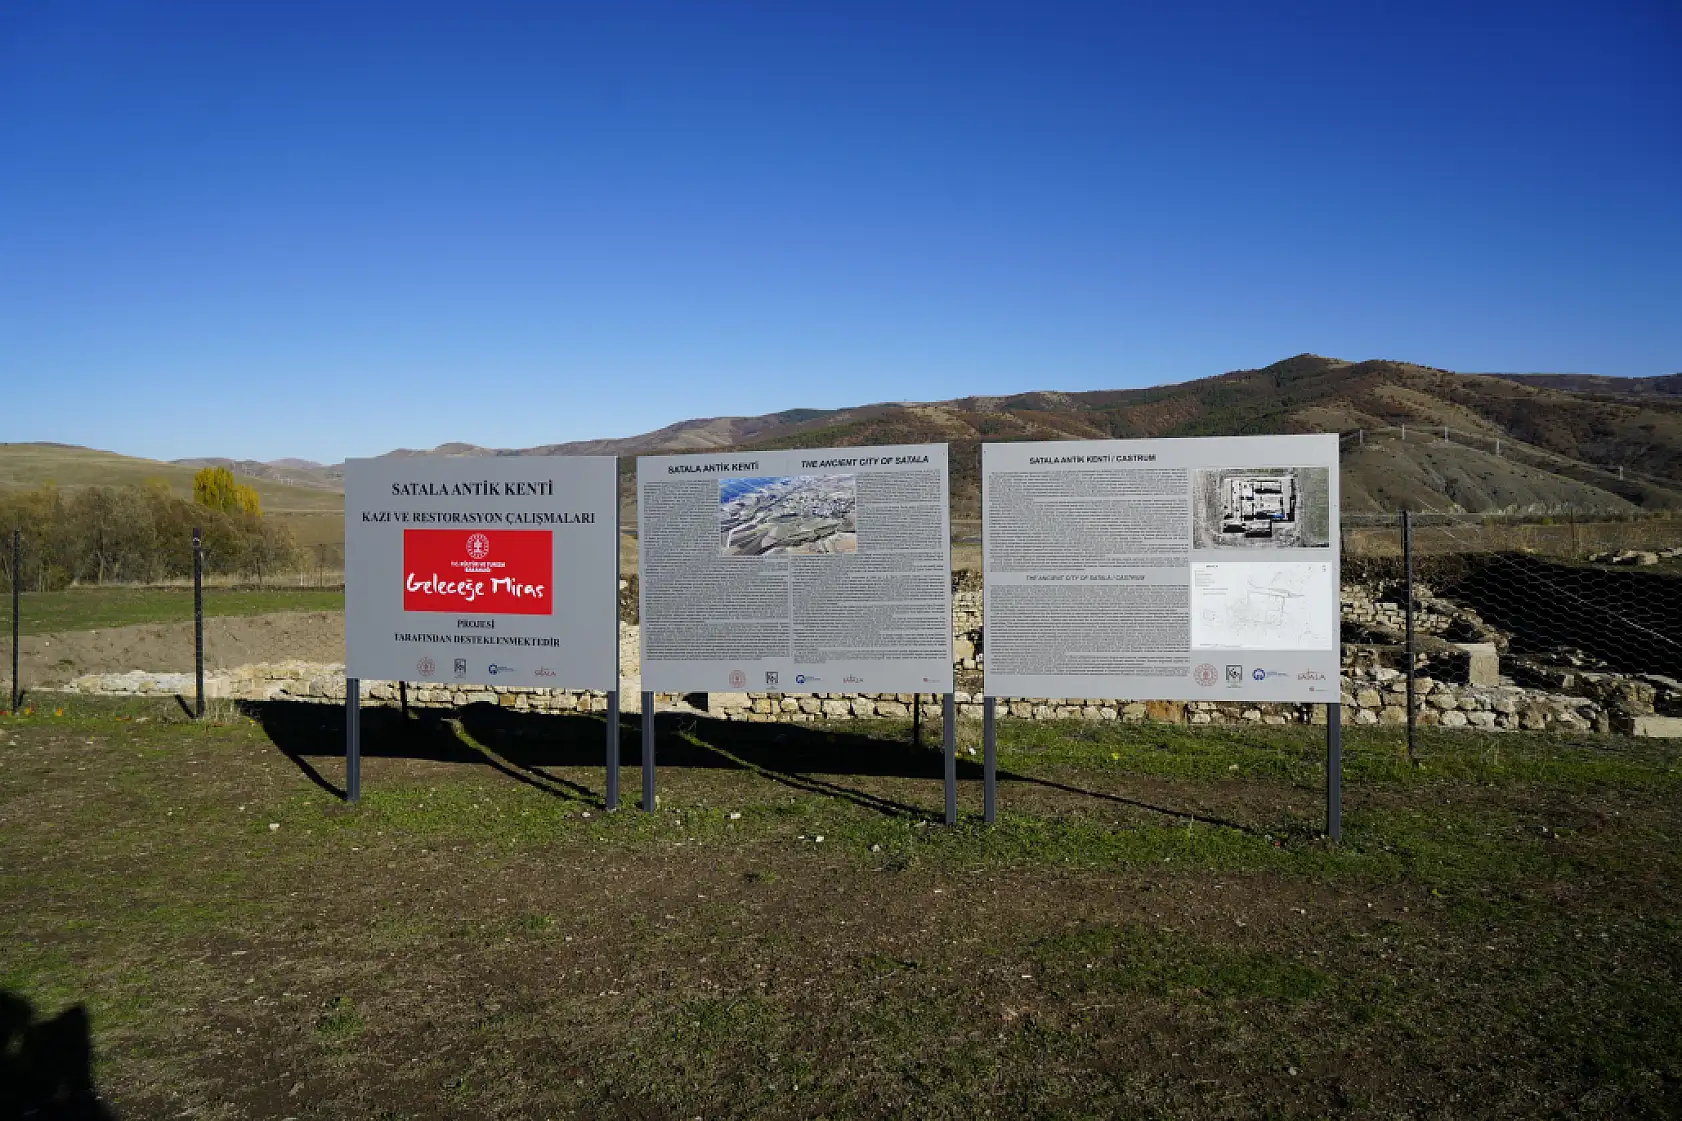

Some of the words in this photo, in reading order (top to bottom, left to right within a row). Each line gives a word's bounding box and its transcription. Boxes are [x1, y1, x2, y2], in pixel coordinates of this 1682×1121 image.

[801, 460, 818, 468] THE
[819, 459, 858, 468] ANCIENT
[859, 457, 879, 466] CITY
[880, 457, 893, 465] OF
[895, 455, 929, 465] SATALA
[1029, 456, 1060, 465] SATALA
[1115, 454, 1157, 462] CASTRUM
[668, 465, 702, 474] SATALA
[703, 462, 730, 473] ANTİK
[731, 461, 760, 471] KENTİ
[391, 482, 449, 496] SATALA
[451, 480, 501, 496] ANTİK
[504, 479, 554, 496] KENTİ
[362, 512, 391, 522] KAZI
[393, 512, 409, 522] VE
[412, 512, 503, 524] RESTORASYON
[505, 512, 596, 526] ÇALIŞMALARI
[406, 572, 485, 601] Geleceğe
[490, 576, 545, 598] Miras
[457, 619, 495, 629] PROJESİ
[394, 633, 452, 643] TARAFINDAN
[453, 635, 560, 647] DESTEKLENMEKTEDİR
